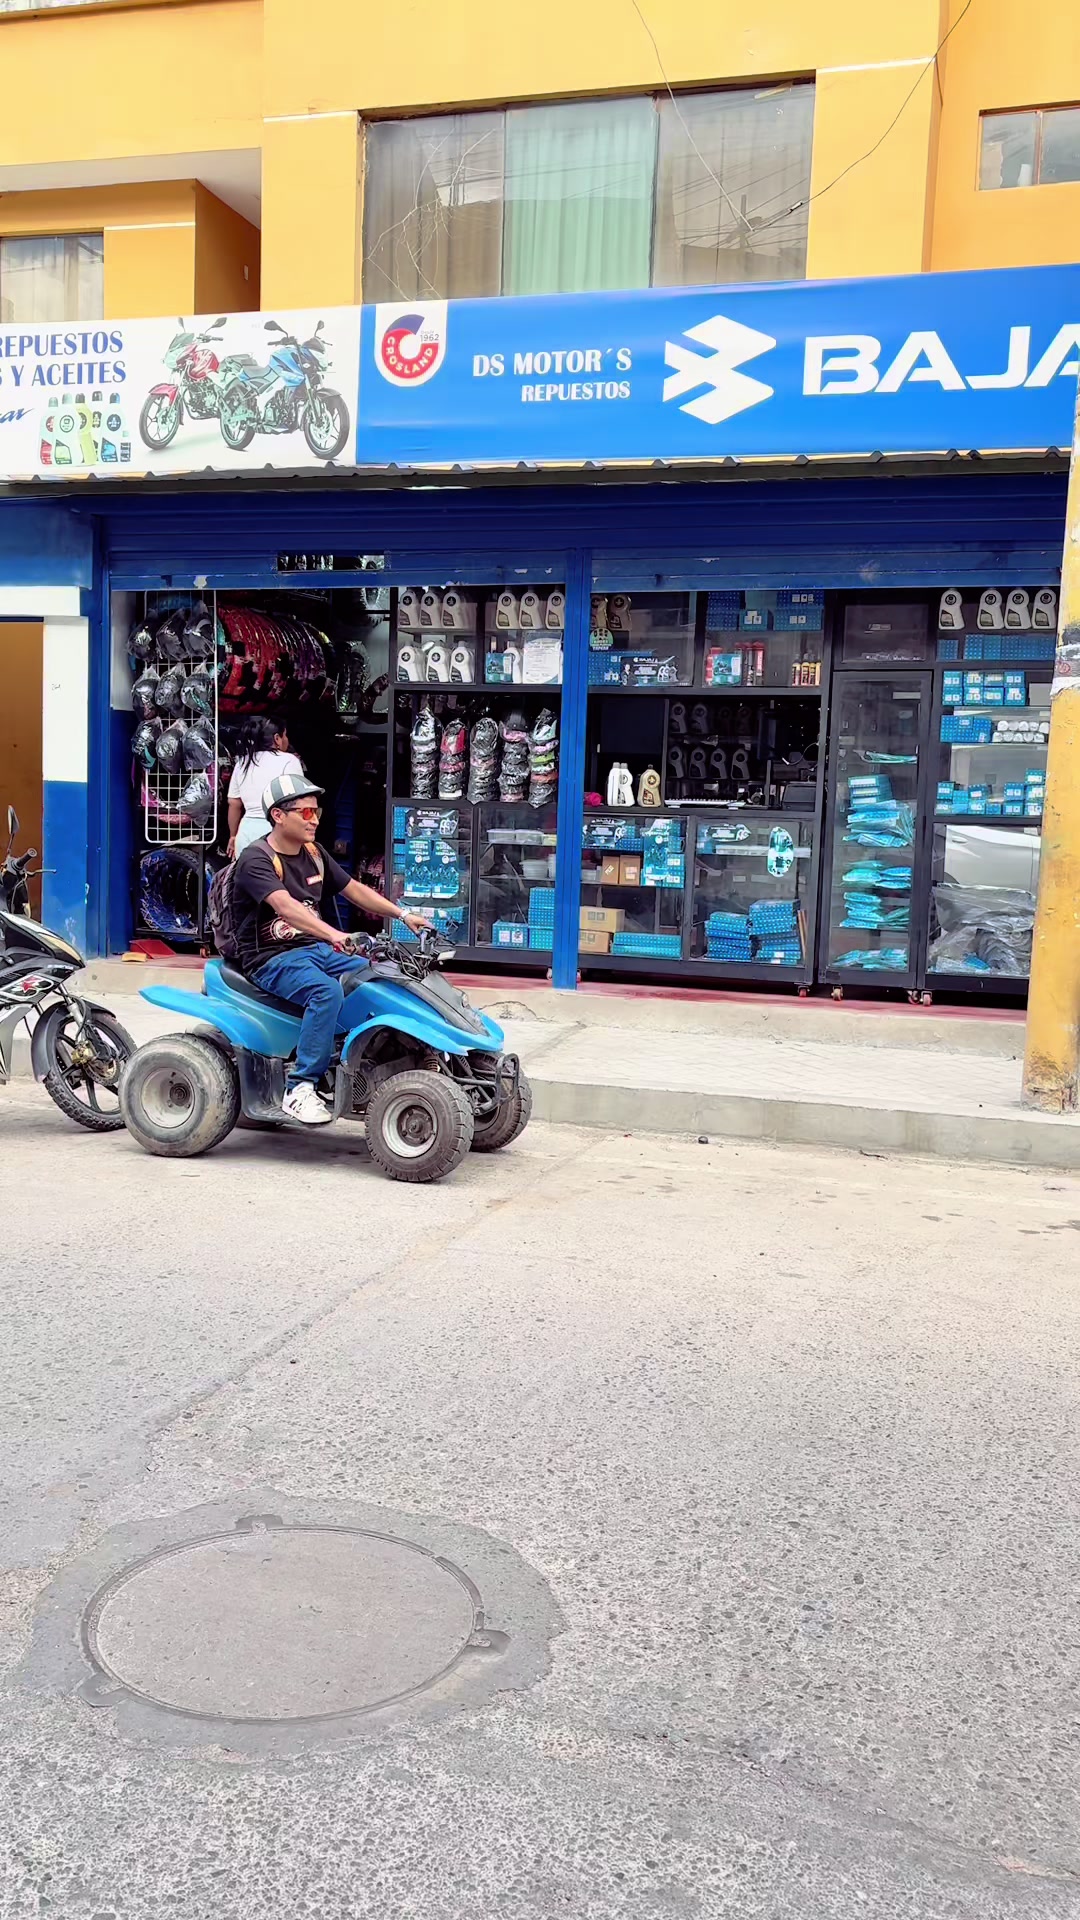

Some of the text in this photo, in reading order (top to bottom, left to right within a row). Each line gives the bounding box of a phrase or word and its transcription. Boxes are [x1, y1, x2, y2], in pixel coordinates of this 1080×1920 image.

[0, 330, 123, 358] EPUESTOS
[420, 333, 440, 342] 1962
[385, 335, 433, 374] CROSLAND
[472, 354, 505, 377] DS
[11, 364, 25, 387] Y
[31, 360, 126, 387] ACEITES
[521, 380, 631, 402] REPUESTOS
